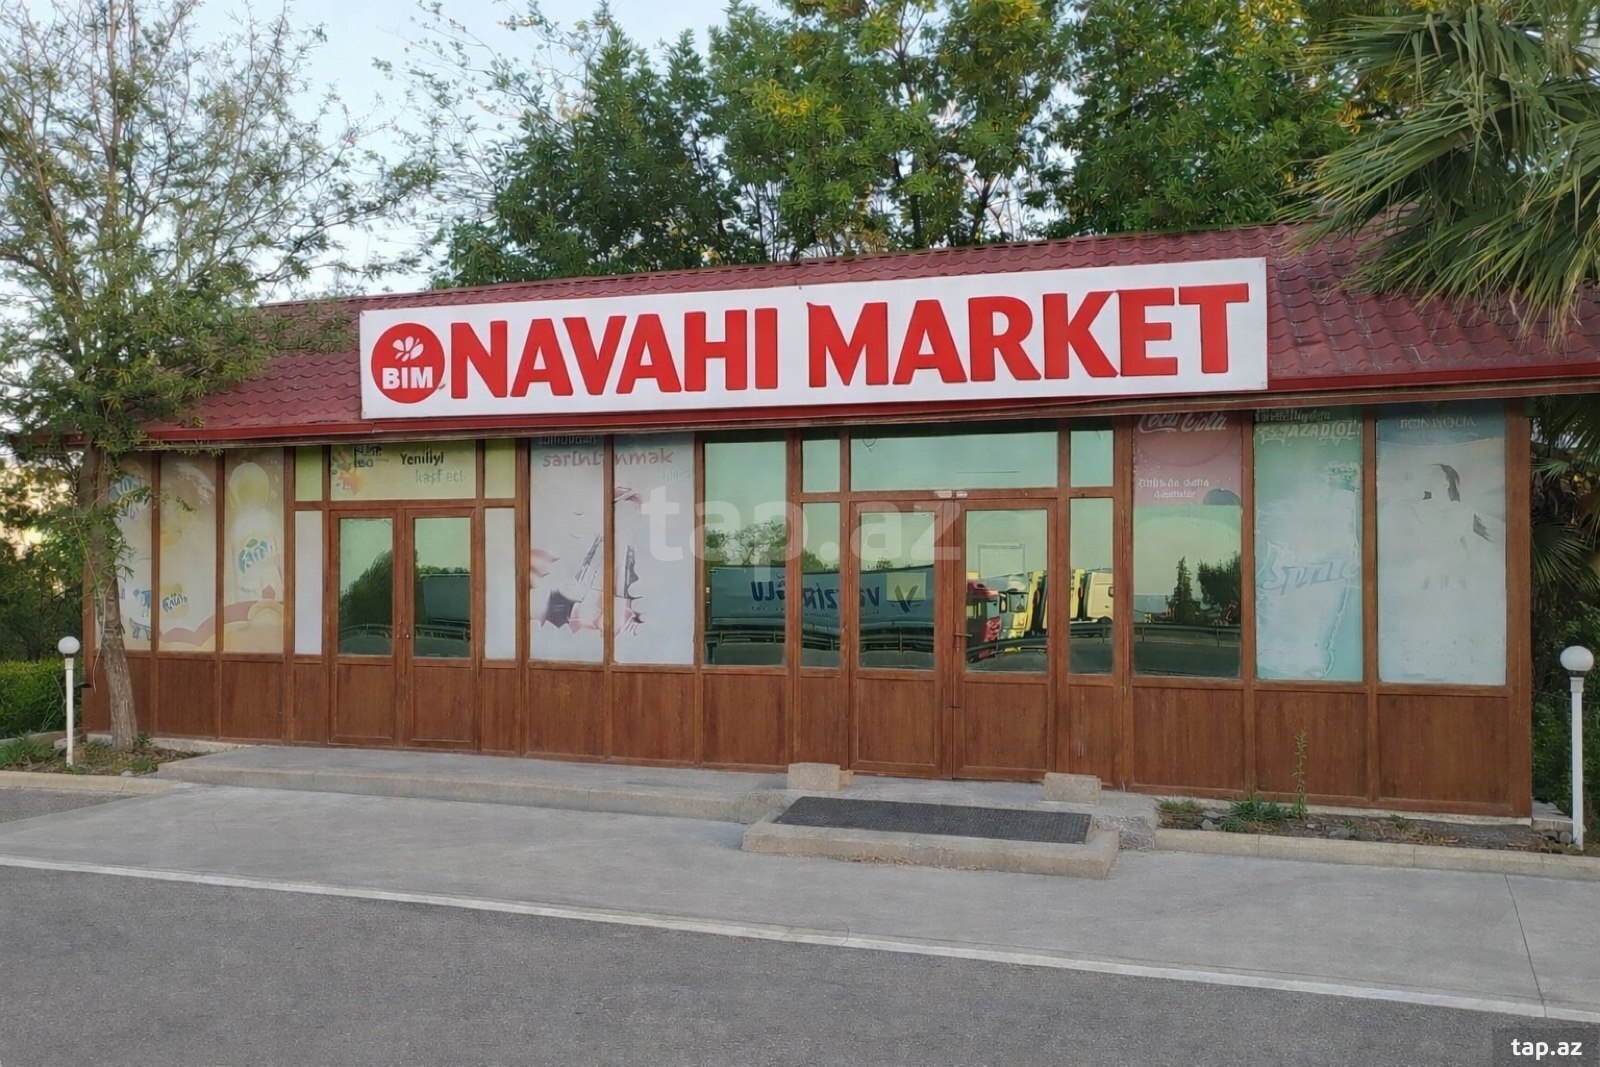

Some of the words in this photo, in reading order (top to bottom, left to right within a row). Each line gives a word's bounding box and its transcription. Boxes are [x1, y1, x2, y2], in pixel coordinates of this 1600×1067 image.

[450, 307, 779, 399] NAVAHI
[806, 283, 1249, 388] MARKET
[381, 366, 433, 390] BIM
